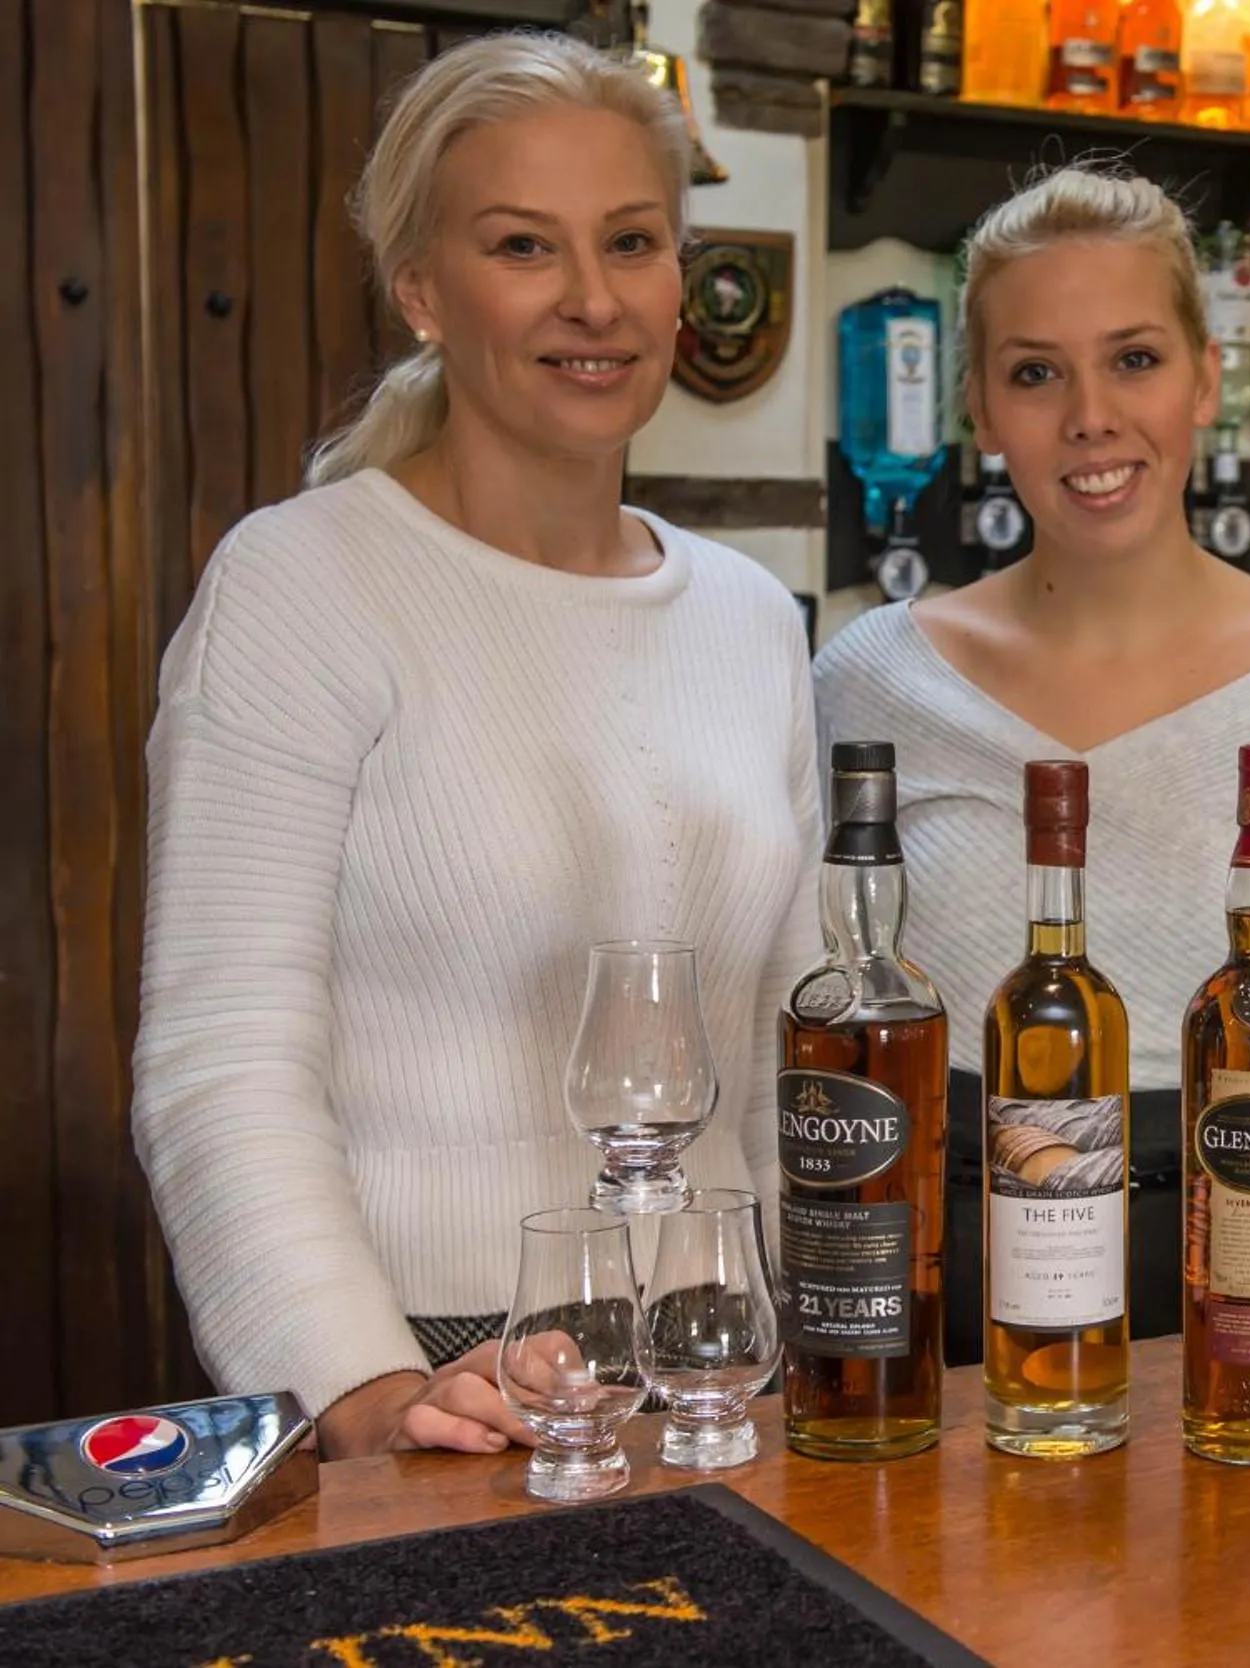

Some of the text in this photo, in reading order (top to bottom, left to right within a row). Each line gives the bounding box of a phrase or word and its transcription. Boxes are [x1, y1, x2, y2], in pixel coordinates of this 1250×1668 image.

[778, 1110, 900, 1144] ENGOYNE
[799, 1156, 831, 1172] 1833
[1022, 1205, 1096, 1223] THE FIVE
[799, 1293, 903, 1319] 21 YEARS
